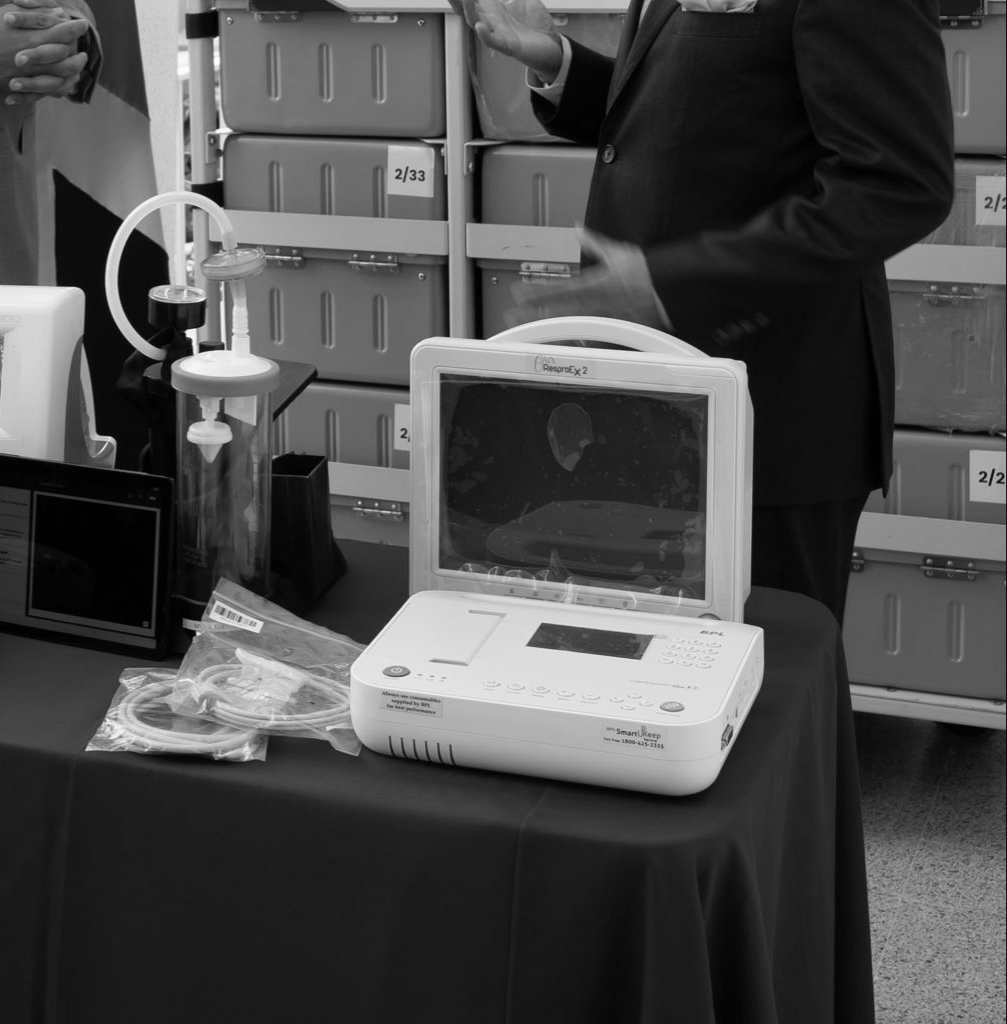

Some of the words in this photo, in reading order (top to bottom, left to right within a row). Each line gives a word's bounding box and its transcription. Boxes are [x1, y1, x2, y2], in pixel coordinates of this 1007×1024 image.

[394, 166, 426, 183] 2/33
[582, 366, 588, 375] 2
[978, 468, 1005, 487] 2/2
